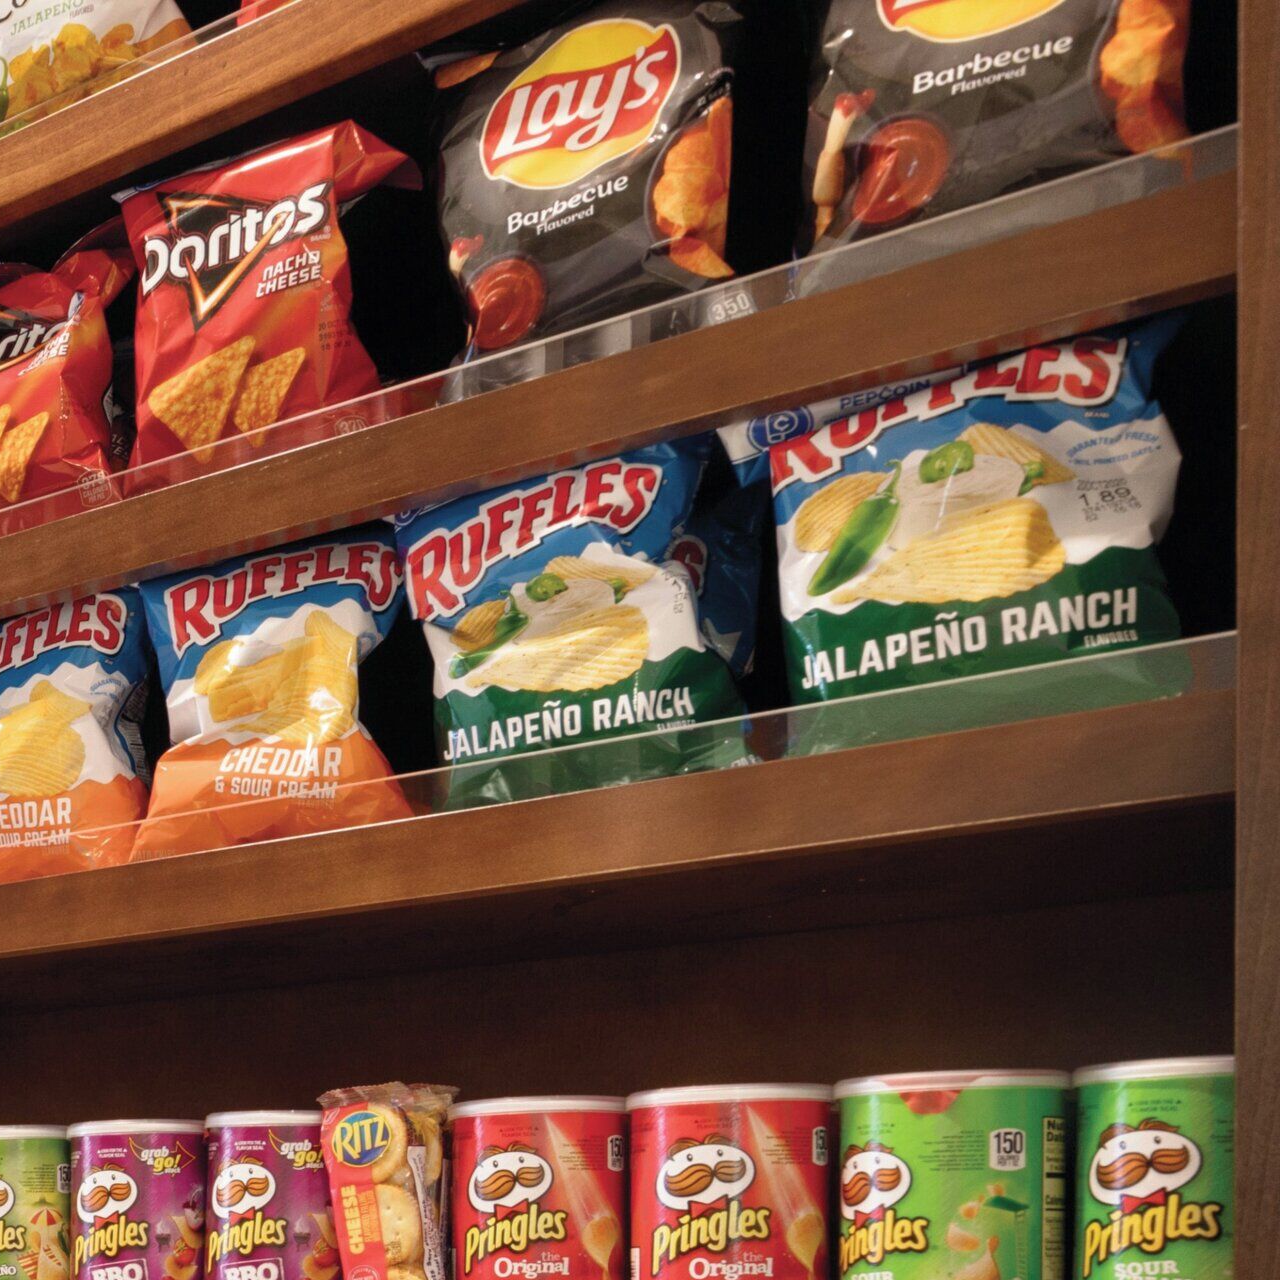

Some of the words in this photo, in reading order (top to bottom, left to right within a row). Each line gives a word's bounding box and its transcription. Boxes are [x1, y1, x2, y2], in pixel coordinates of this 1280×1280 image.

[912, 35, 1073, 95] Barbecue
[951, 65, 1027, 96] Flavored
[490, 46, 669, 160] Lay's
[506, 175, 629, 234] Barbecue
[536, 205, 595, 236] Flavored
[140, 182, 333, 297] Doritos
[256, 264, 322, 298] CHEESE
[406, 462, 658, 622] RUFFLES
[167, 542, 404, 654] RUFFLES
[802, 611, 988, 690] JALAPEÑO
[1001, 586, 1138, 646] RANCH
[444, 699, 582, 760] JALAPEÑO
[593, 686, 696, 731] RANCH
[220, 746, 343, 779] CHEDDAR
[230, 777, 272, 799] SOUR
[140, 1147, 170, 1161] grab
[280, 1140, 312, 1155] grab
[336, 1114, 388, 1163] RITZ
[993, 1131, 1024, 1155] 150
[74, 1216, 149, 1277] Pringles
[208, 1211, 286, 1274] Pringles
[341, 1184, 366, 1255] CHEESE
[465, 1203, 567, 1275] Pringles
[651, 1200, 771, 1277] Pringles
[1083, 1192, 1221, 1279] Pringles
[494, 1256, 570, 1279] Original
[542, 1250, 560, 1262] the
[744, 1251, 763, 1263] the
[1114, 1260, 1179, 1280] SOUR
